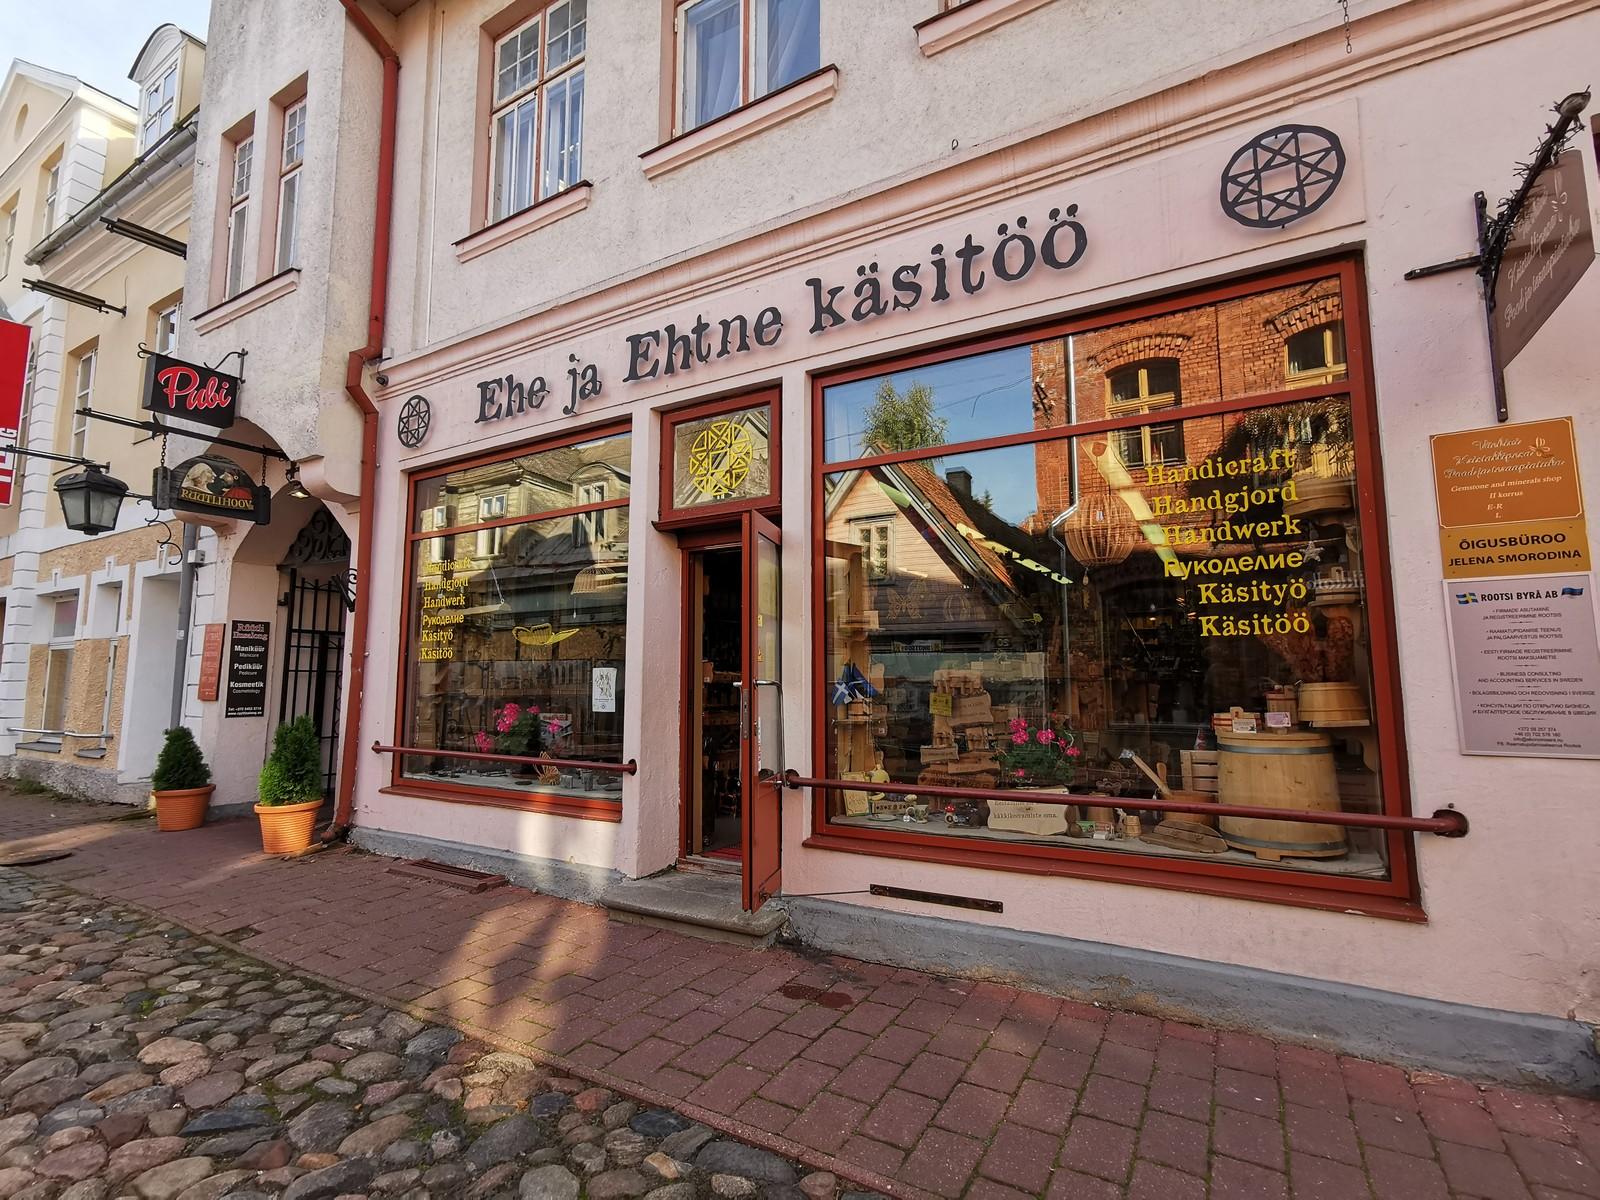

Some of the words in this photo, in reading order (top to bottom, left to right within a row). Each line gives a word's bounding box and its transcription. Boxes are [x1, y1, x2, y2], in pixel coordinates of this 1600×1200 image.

[474, 375, 552, 425] Ehe
[563, 353, 603, 416] ja
[622, 304, 784, 384] Ehtne
[805, 203, 1089, 337] käsitöö
[157, 366, 232, 410] Pubi
[1145, 448, 1296, 486] Handicraft
[1451, 482, 1489, 493] Gemstone
[1490, 480, 1506, 488] and
[1507, 477, 1541, 487] minerals
[1542, 475, 1562, 484] shop
[181, 489, 253, 509] RÜÜTLIHOOV
[1152, 480, 1299, 517] Handgjord
[1498, 490, 1524, 498] korrus
[1162, 514, 1302, 546] Handwerk
[1459, 533, 1566, 550] ÕIGUSBÜROO
[1164, 551, 1303, 580] Рукоделие
[1448, 555, 1495, 567] JELENA
[1498, 549, 1581, 563] SMORODINA
[424, 577, 468, 591] Handgjord
[1197, 578, 1307, 606] Käsityö
[424, 594, 465, 608] Handwerk
[1481, 592, 1513, 602] ROOTSI
[1516, 590, 1542, 600] BYRÅ
[1545, 590, 1559, 599] AB
[422, 614, 464, 628] Рукоделие
[1198, 612, 1310, 637] Käsitöö
[422, 629, 453, 643] Käsityö
[421, 647, 453, 660] Käsitöö
